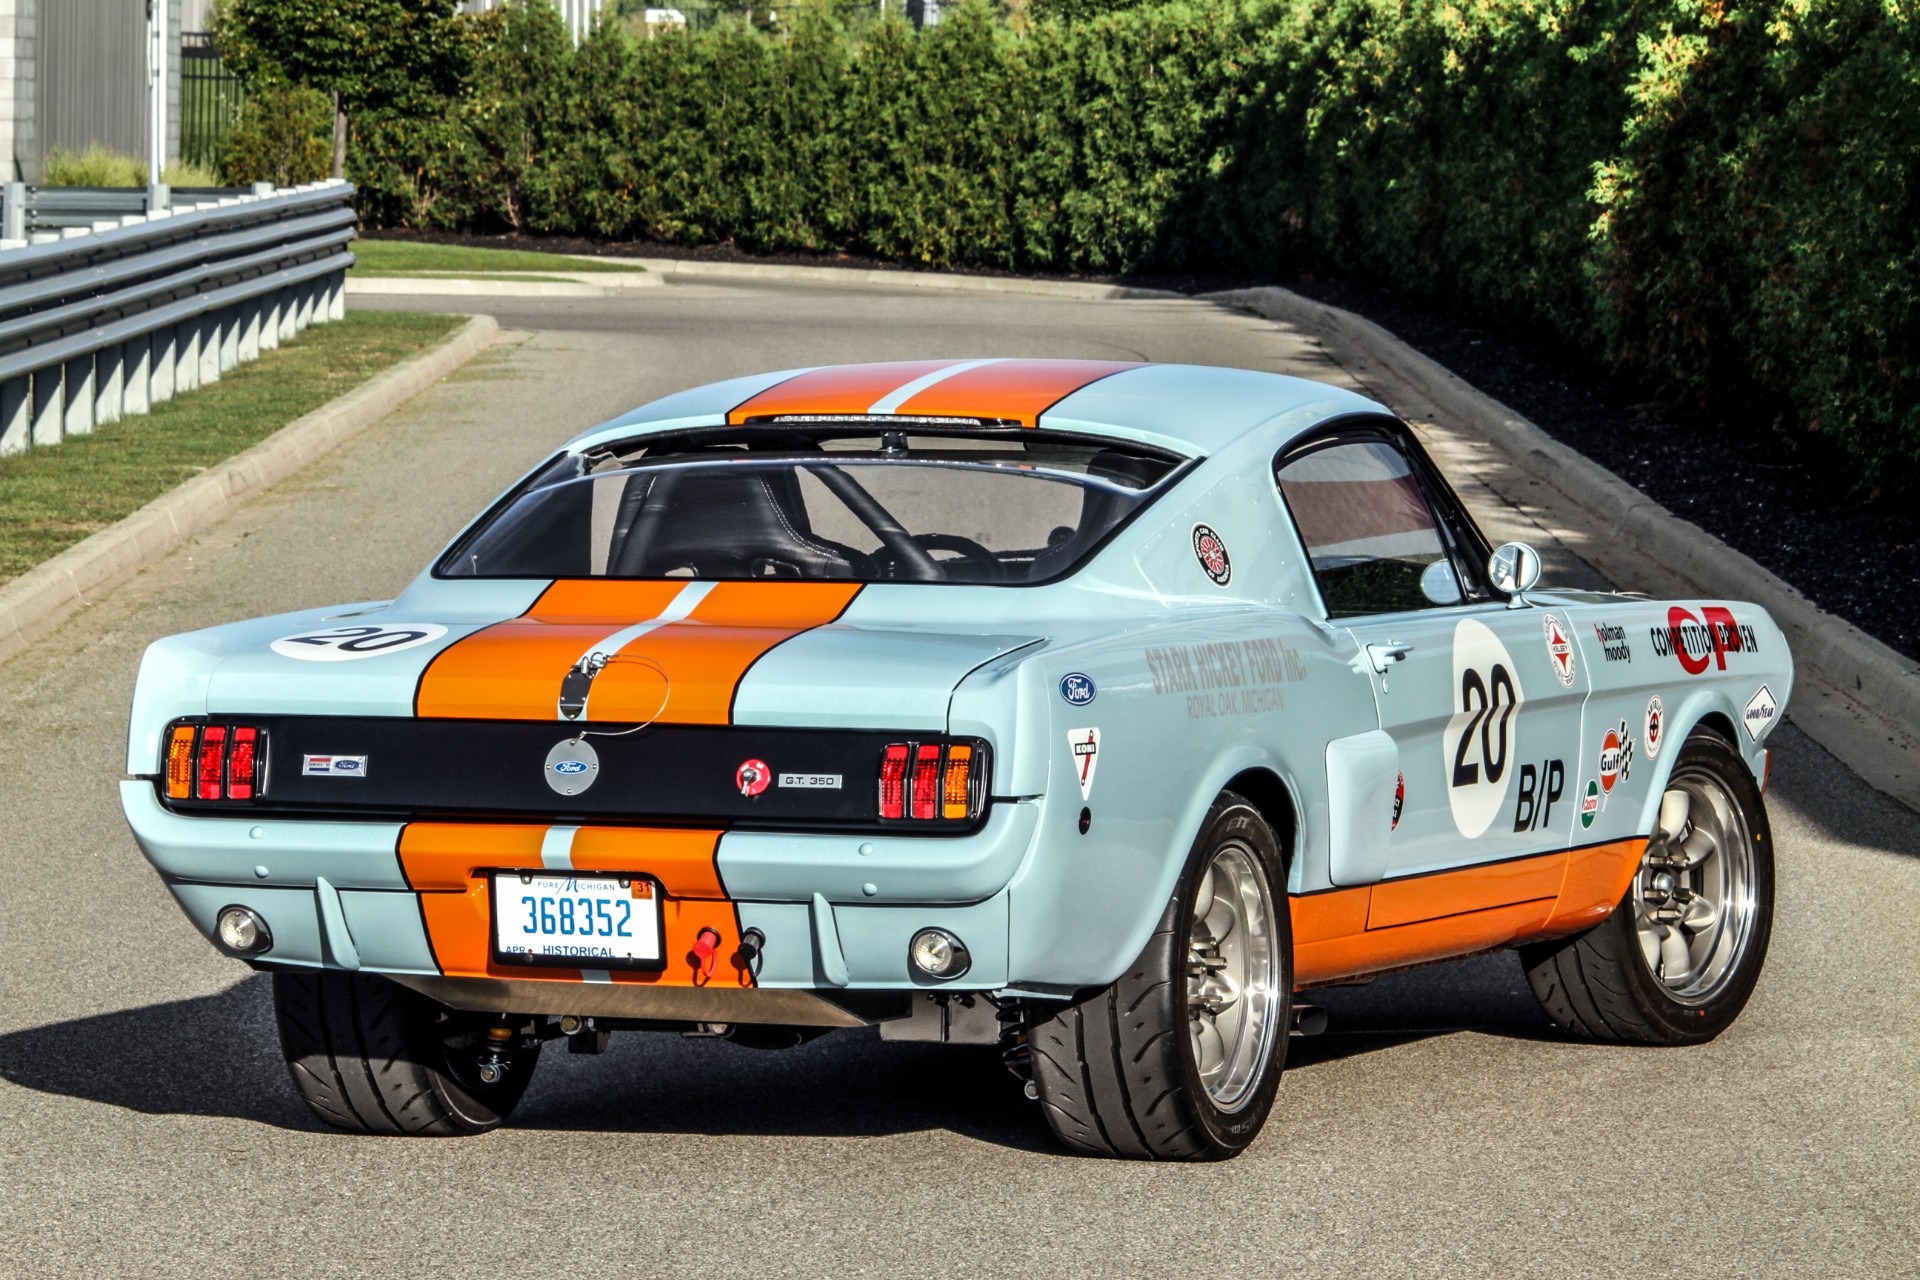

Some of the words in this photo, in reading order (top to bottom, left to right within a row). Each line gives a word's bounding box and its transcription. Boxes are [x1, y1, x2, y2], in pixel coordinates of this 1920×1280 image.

[284, 627, 428, 652] 20
[1593, 622, 1627, 645] holman
[1650, 625, 1719, 657] COMPETITION
[1716, 625, 1758, 653] PROVEN
[1667, 606, 1742, 675] CP
[1604, 641, 1631, 663] moody
[1144, 645, 1198, 695] STARK
[1191, 640, 1246, 689] HICKEY
[1242, 638, 1283, 685] FORD
[1067, 677, 1090, 699] Ford
[1187, 694, 1217, 720] ROYAL
[1241, 687, 1284, 714] MICHIGAN
[1452, 663, 1516, 788] 20
[1076, 744, 1095, 754] KONI
[339, 761, 356, 769] Ford
[560, 762, 582, 772] Ford
[1601, 753, 1619, 772] Gulf
[785, 776, 805, 785] G.T.
[809, 777, 834, 786] 350
[1513, 758, 1565, 833] B/P
[537, 881, 559, 889] PURE
[556, 877, 616, 895] MICHIGAN
[637, 882, 650, 893] 31
[521, 896, 633, 937] 368352
[505, 946, 526, 954] APR
[542, 945, 616, 958] HISTORICAL
